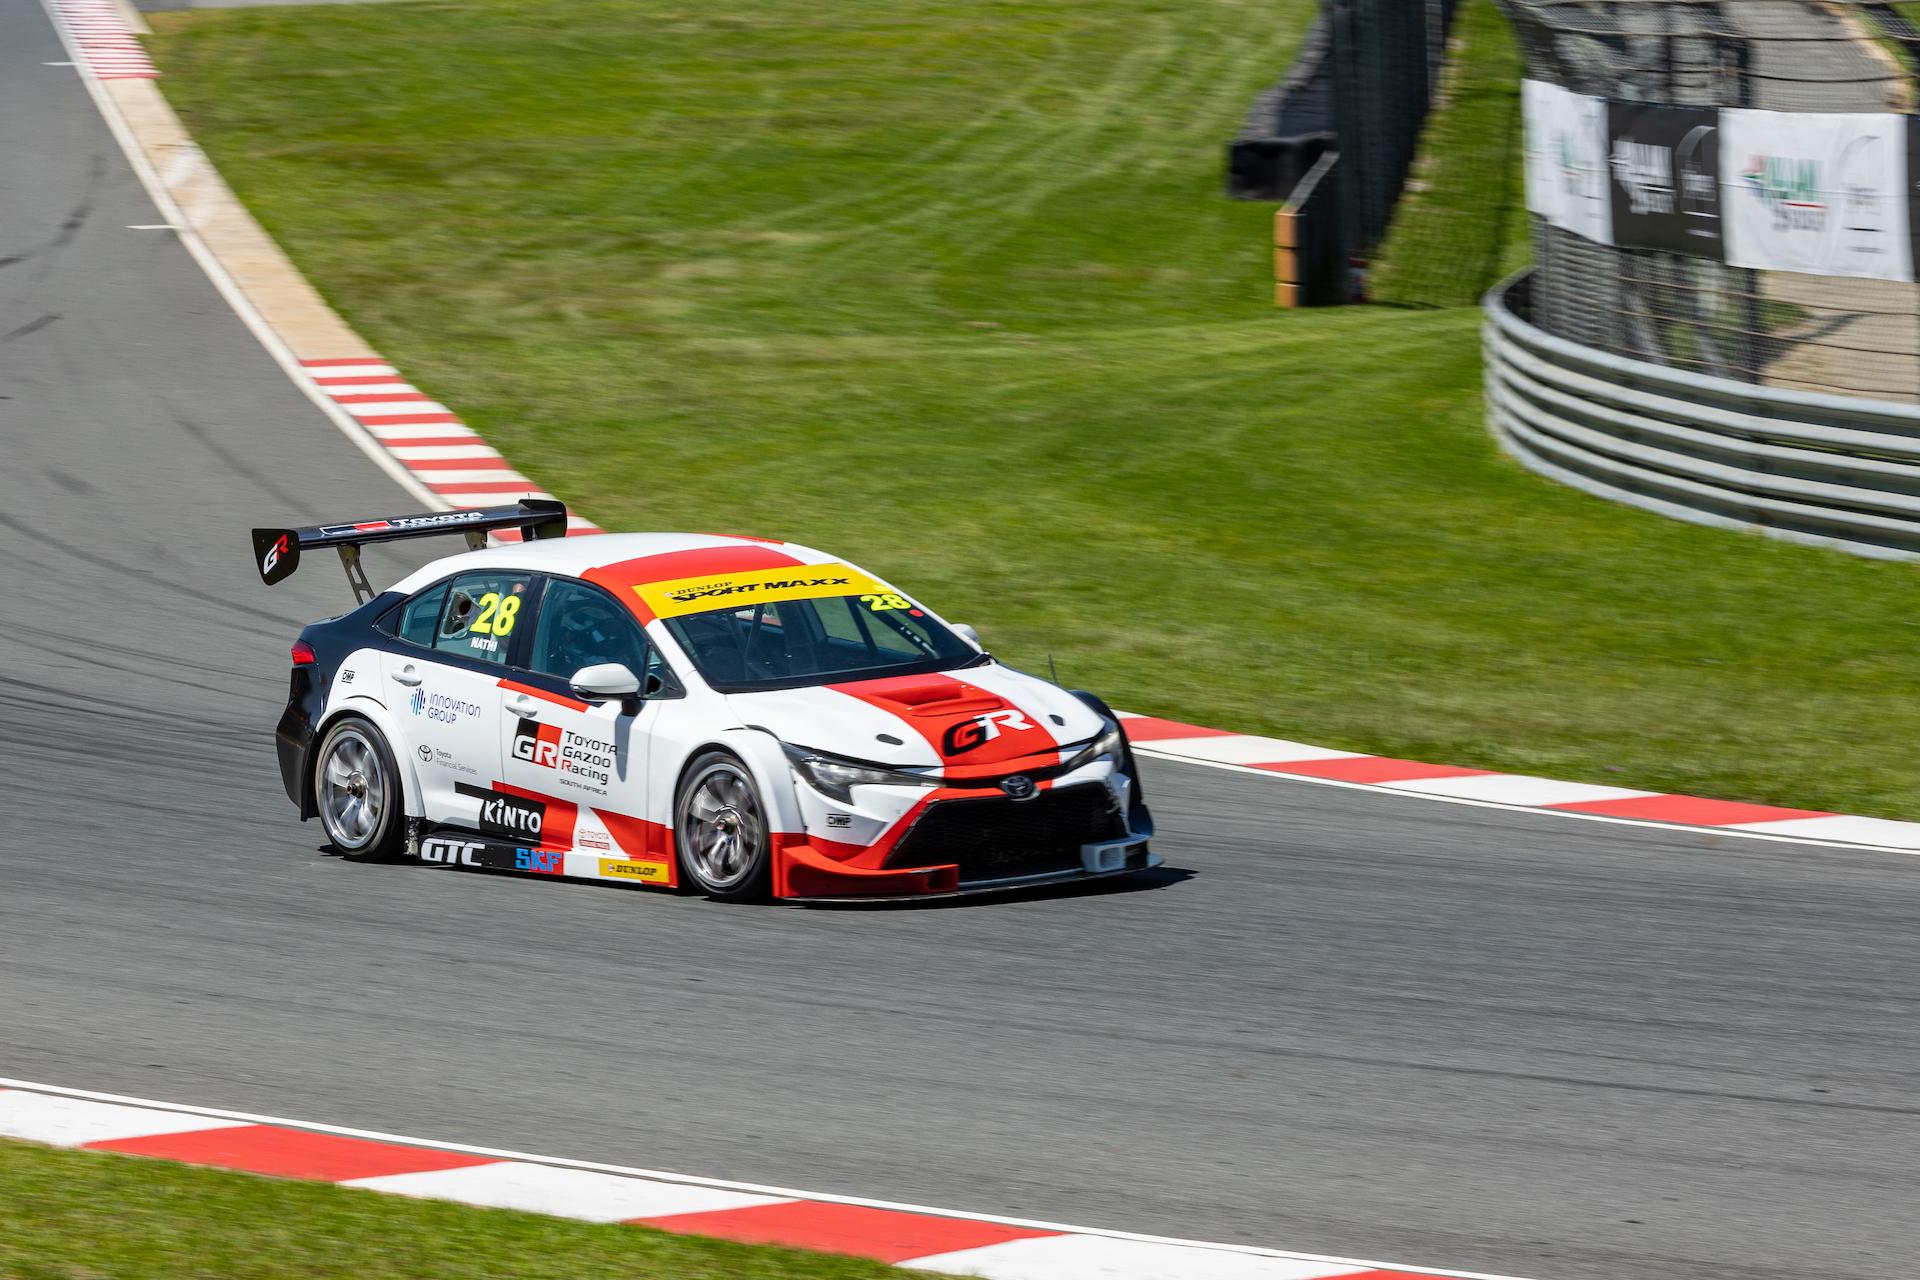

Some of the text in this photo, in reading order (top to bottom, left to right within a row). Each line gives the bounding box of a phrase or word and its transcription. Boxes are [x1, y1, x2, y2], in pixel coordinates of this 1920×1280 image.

[392, 512, 484, 528] TOYOTA
[263, 534, 289, 574] GR
[672, 578, 850, 602] SPORT MAXX
[677, 582, 732, 595] DUNLOP
[470, 592, 520, 636] 28
[859, 594, 912, 611] 28
[470, 636, 498, 652] NATHI
[428, 707, 457, 724] GROUP
[565, 730, 617, 755] TOYOTA
[943, 710, 1035, 757] GR
[436, 748, 452, 759] Toyota
[513, 734, 557, 768] GR
[563, 746, 611, 768] GAZOO
[561, 759, 608, 785] Racing
[559, 779, 608, 796] SOUTH AFRICA
[421, 838, 486, 867] GTC
[515, 847, 562, 872] SKF
[616, 864, 657, 876] DUNLOP
